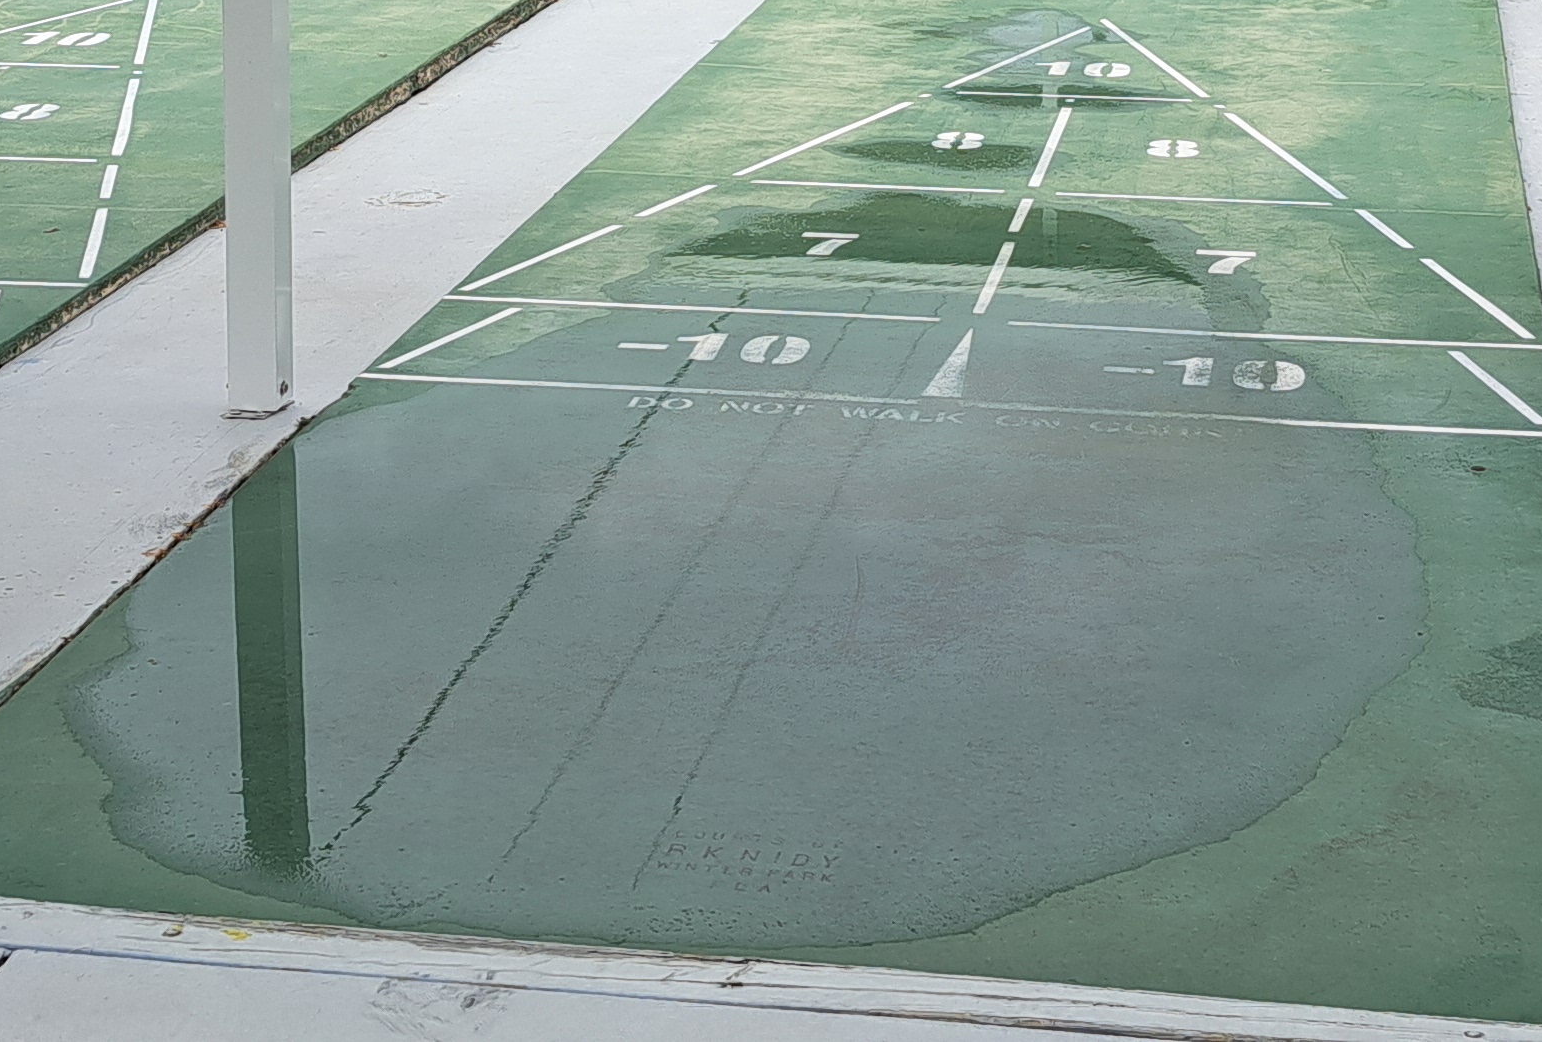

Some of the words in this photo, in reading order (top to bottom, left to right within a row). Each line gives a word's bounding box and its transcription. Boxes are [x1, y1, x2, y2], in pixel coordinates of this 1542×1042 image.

[20, 31, 110, 47] 10
[1035, 61, 1131, 78] 10
[931, 131, 985, 150] 8
[1147, 139, 1200, 157] 8
[801, 232, 859, 256] 7
[1195, 249, 1257, 275] 7
[617, 332, 811, 364] -10
[1103, 357, 1306, 391] -10
[627, 396, 694, 410] DO
[720, 400, 816, 416] NOT
[841, 407, 968, 424] WALK
